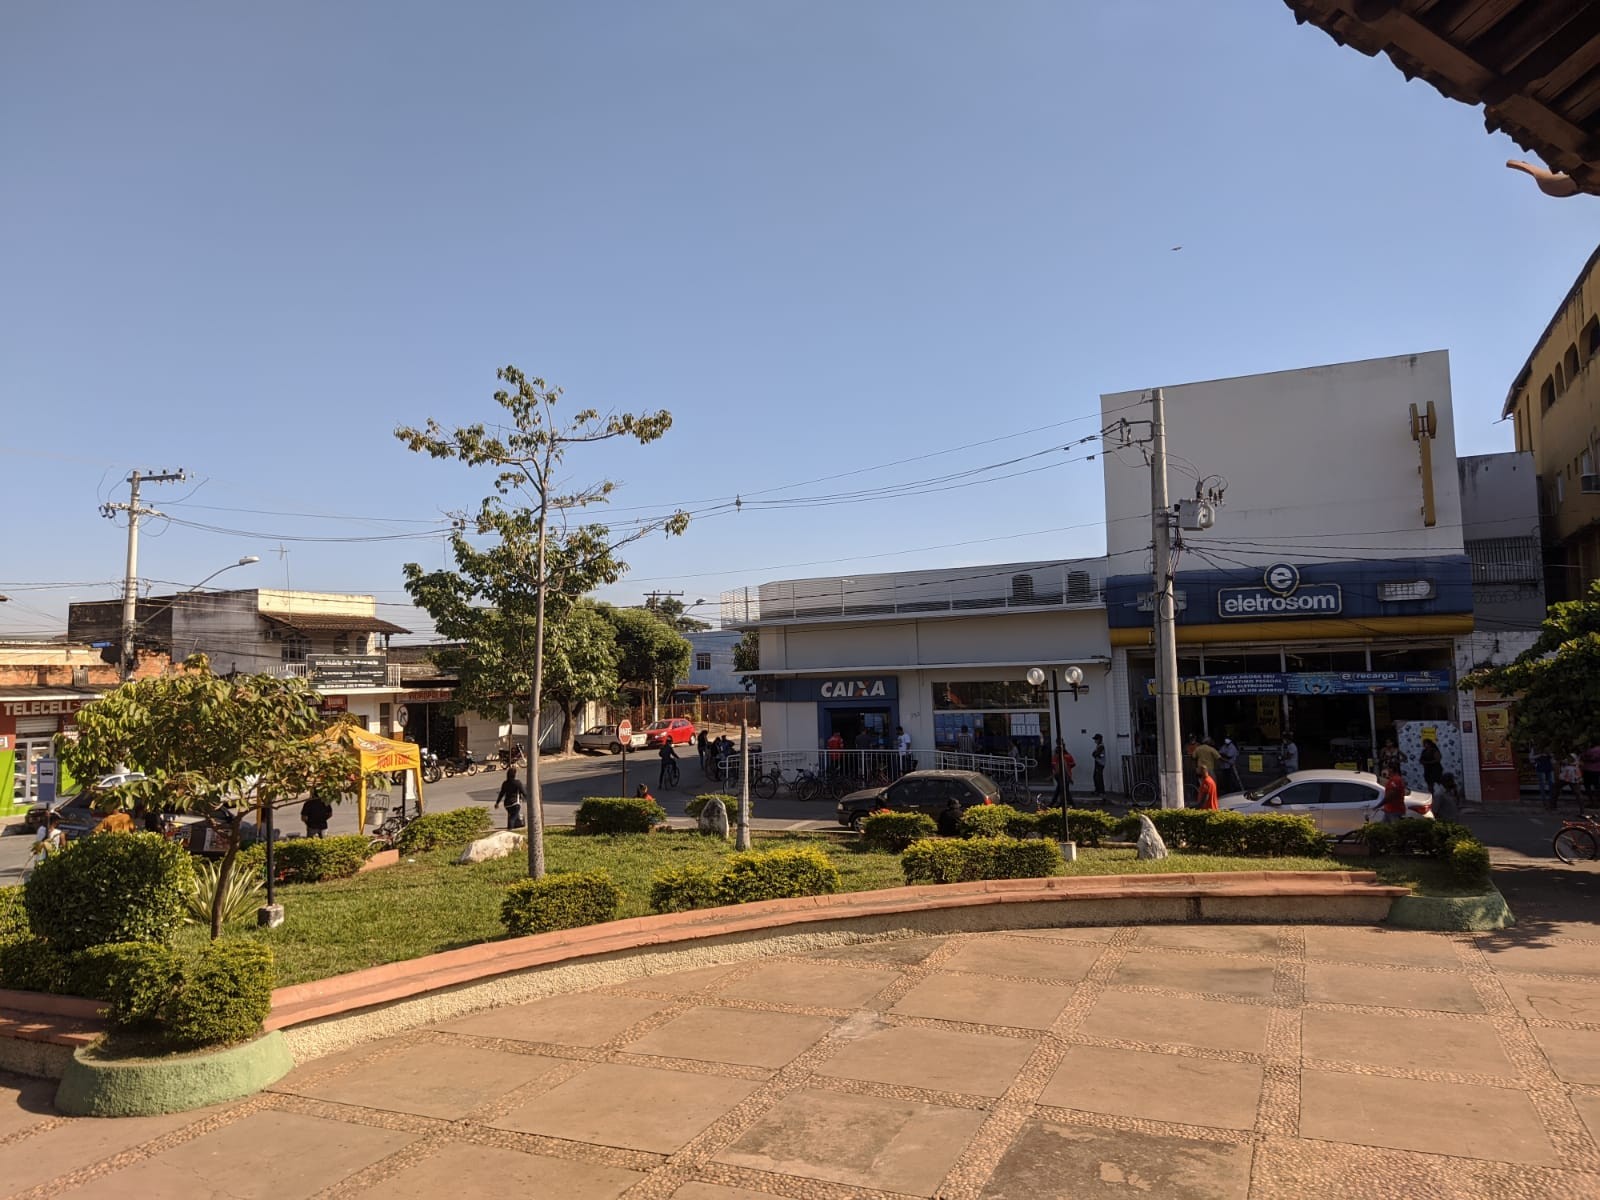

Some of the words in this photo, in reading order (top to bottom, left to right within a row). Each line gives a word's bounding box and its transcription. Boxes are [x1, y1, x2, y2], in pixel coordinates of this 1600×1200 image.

[1224, 593, 1335, 612] eletrosom
[820, 680, 886, 698] CAIXA
[3, 701, 76, 716] TELECELL
[620, 727, 632, 736] PARE
